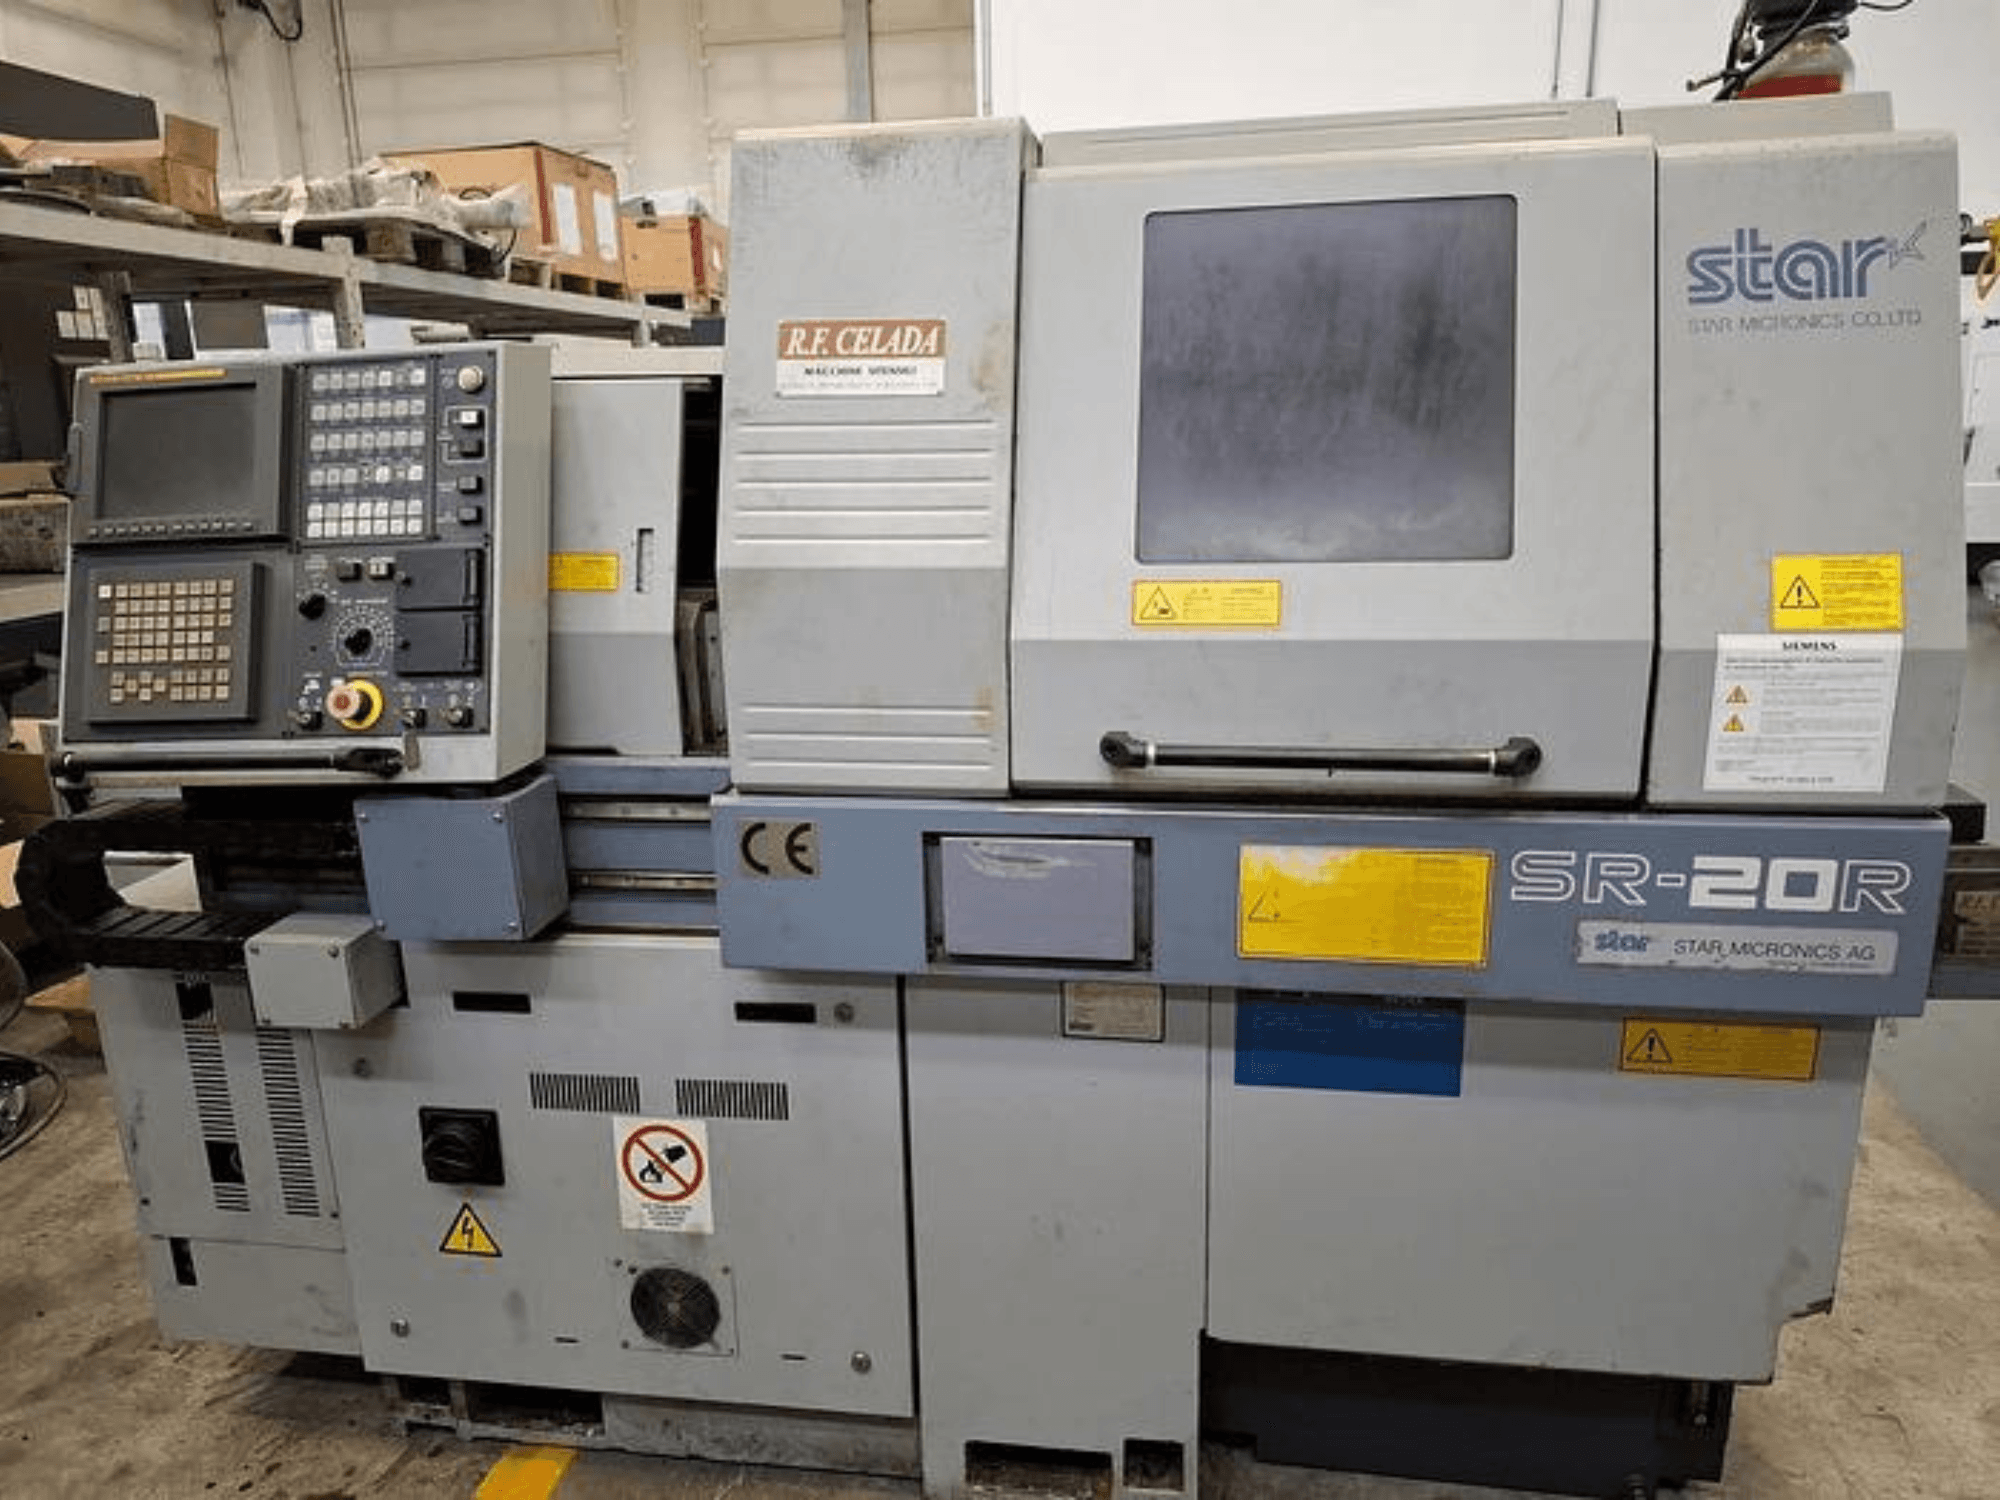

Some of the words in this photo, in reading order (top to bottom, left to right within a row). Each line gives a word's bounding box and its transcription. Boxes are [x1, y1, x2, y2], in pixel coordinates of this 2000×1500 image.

[1687, 227, 1886, 303] star
[836, 325, 939, 355] CELADA
[742, 822, 814, 875] CE
[1511, 850, 1911, 914] SR-20R
[1595, 931, 1647, 952] star
[1673, 939, 1720, 956] STAR
[1727, 941, 1841, 960] MICRONICS
[1847, 944, 1876, 961] AG
